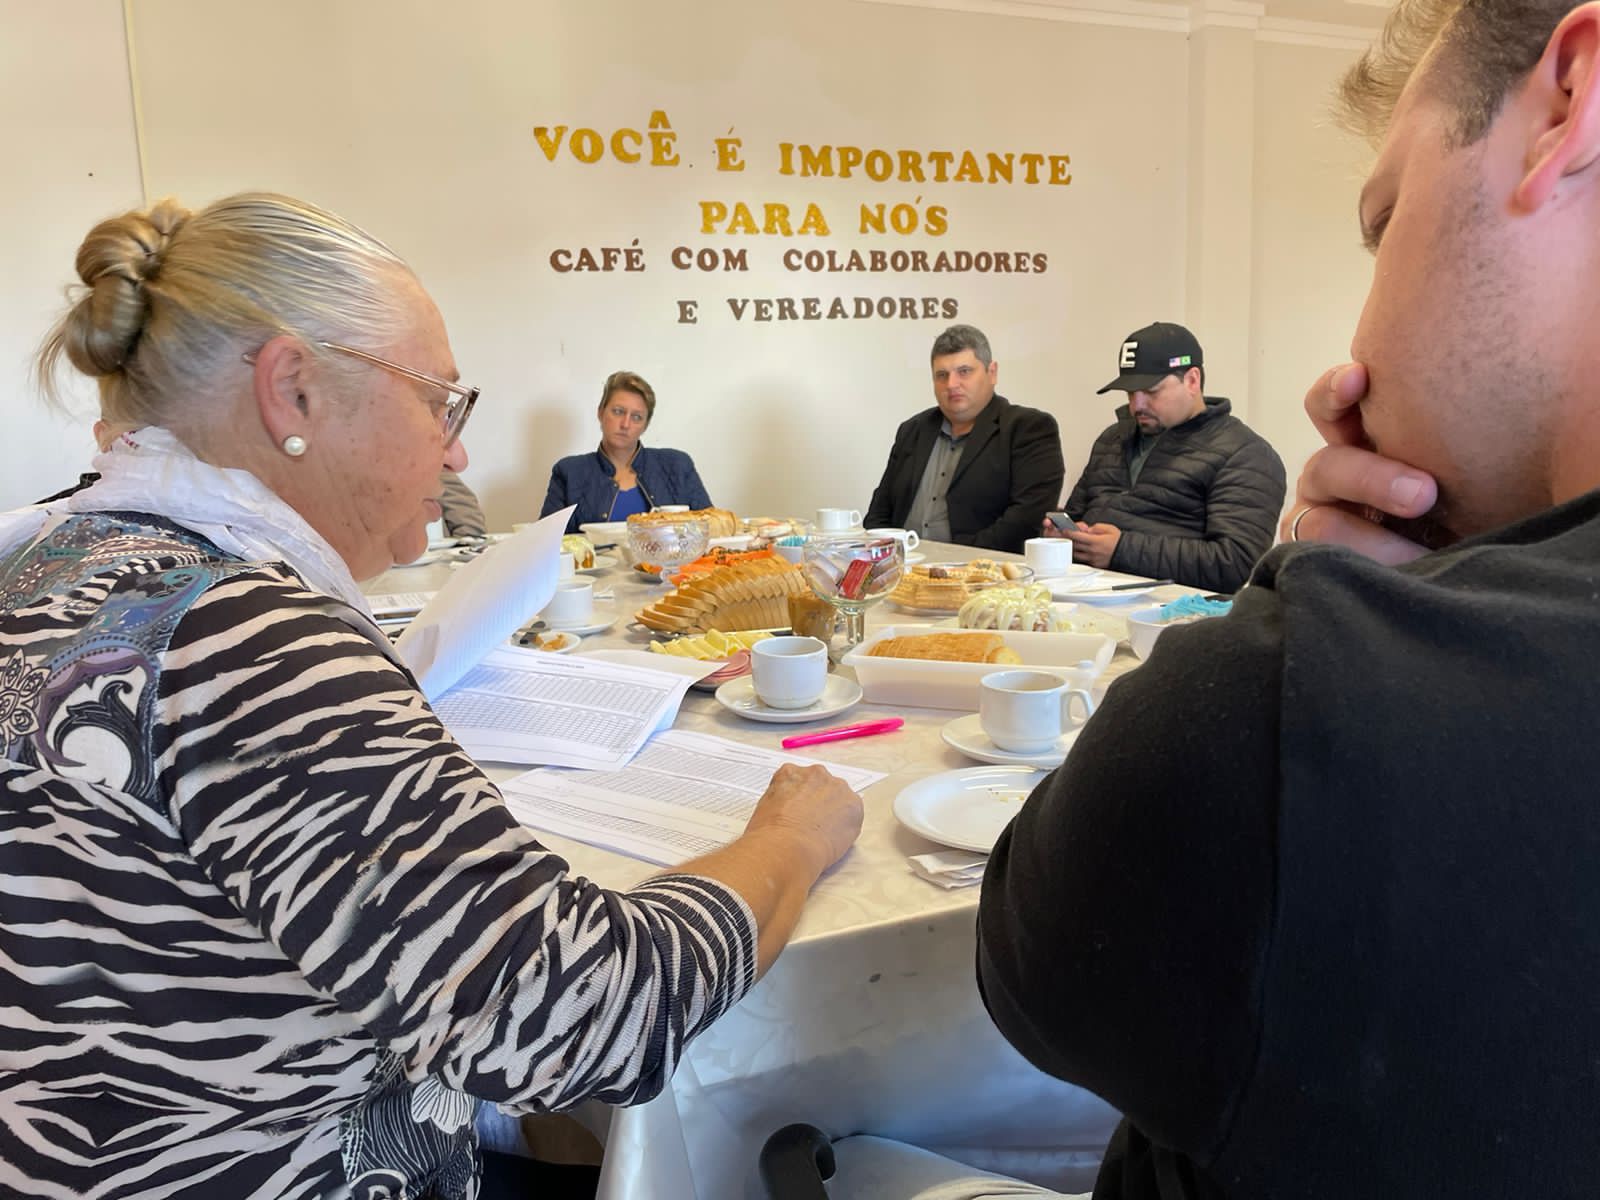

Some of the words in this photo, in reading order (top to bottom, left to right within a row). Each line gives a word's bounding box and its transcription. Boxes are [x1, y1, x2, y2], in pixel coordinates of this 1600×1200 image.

[533, 110, 681, 166] VOCÊ
[715, 127, 746, 172] É
[778, 142, 1073, 186] IMPORTANTE
[699, 200, 831, 237] PARA
[859, 196, 949, 237] NÓS
[549, 238, 645, 273] CAFÉ
[671, 246, 748, 272] COM
[783, 247, 1048, 274] COLABORADORES
[677, 300, 698, 324] E
[727, 297, 959, 321] VEREADORES
[1121, 340, 1139, 369] E
